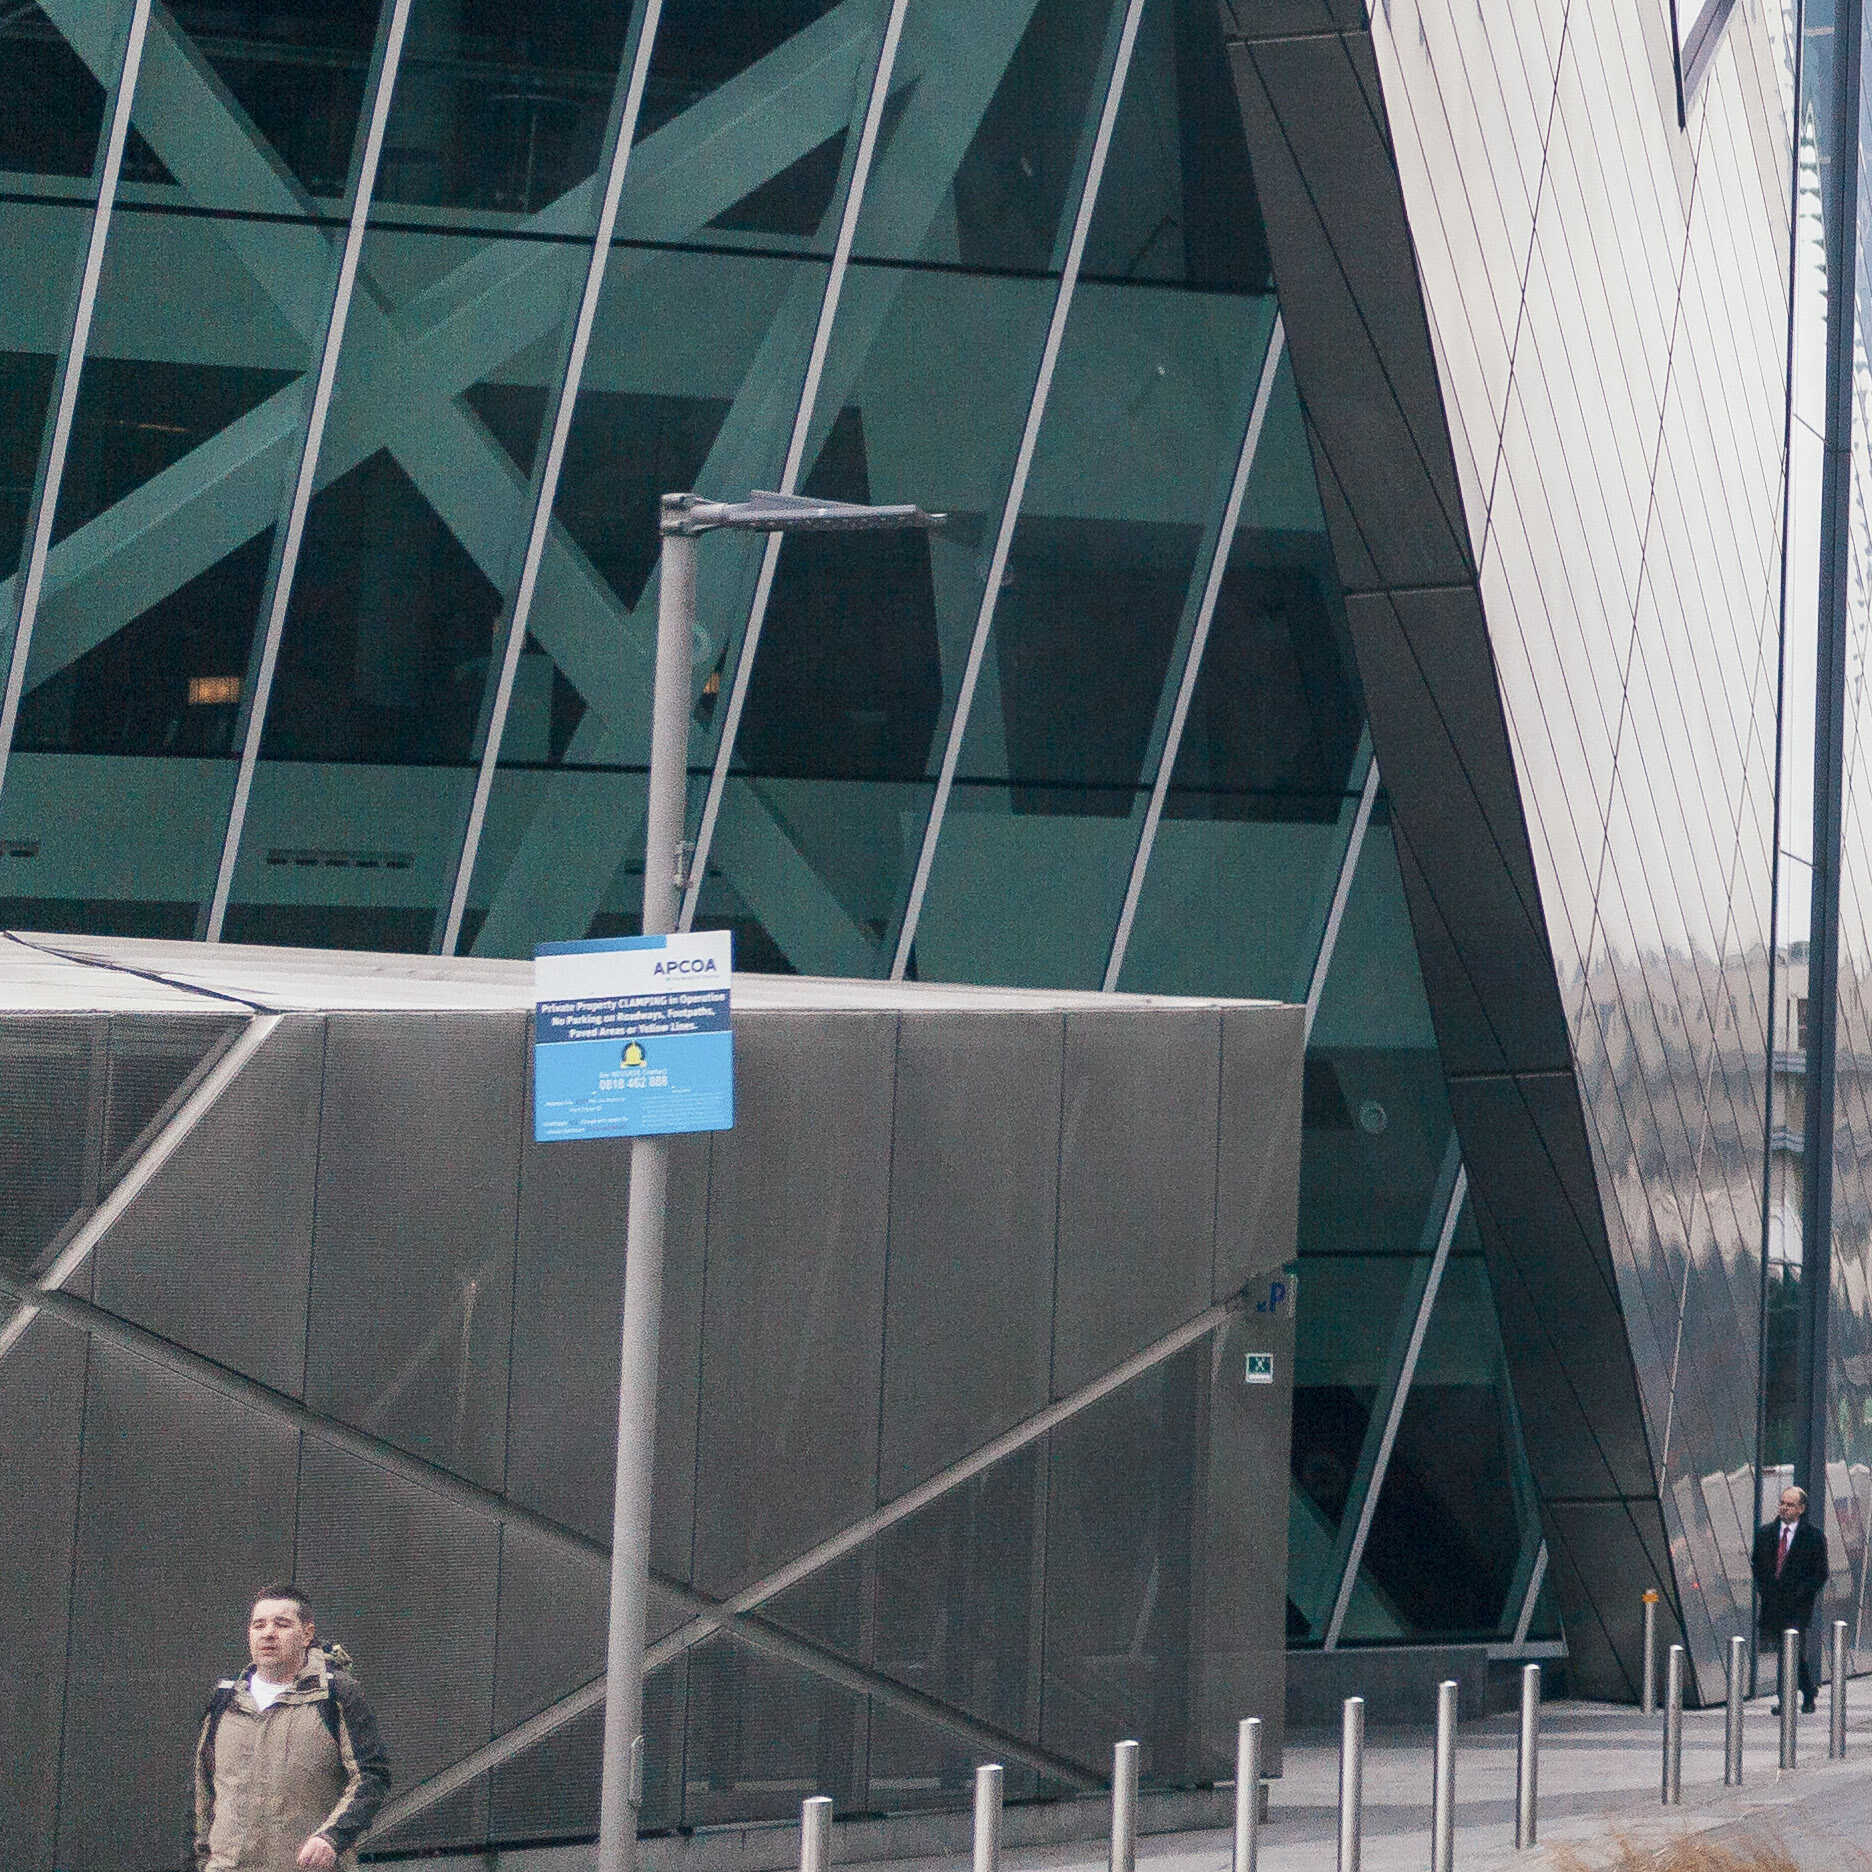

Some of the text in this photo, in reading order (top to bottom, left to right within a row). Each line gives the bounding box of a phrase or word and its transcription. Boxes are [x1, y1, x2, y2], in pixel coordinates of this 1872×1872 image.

[654, 958, 717, 975] APCOA
[541, 1003, 576, 1014] Private
[576, 1000, 617, 1013] Property
[618, 996, 668, 1008] CLAMPING
[680, 992, 726, 1006] Operation
[566, 1014, 603, 1026] Parking
[1269, 1281, 1286, 1313] P
